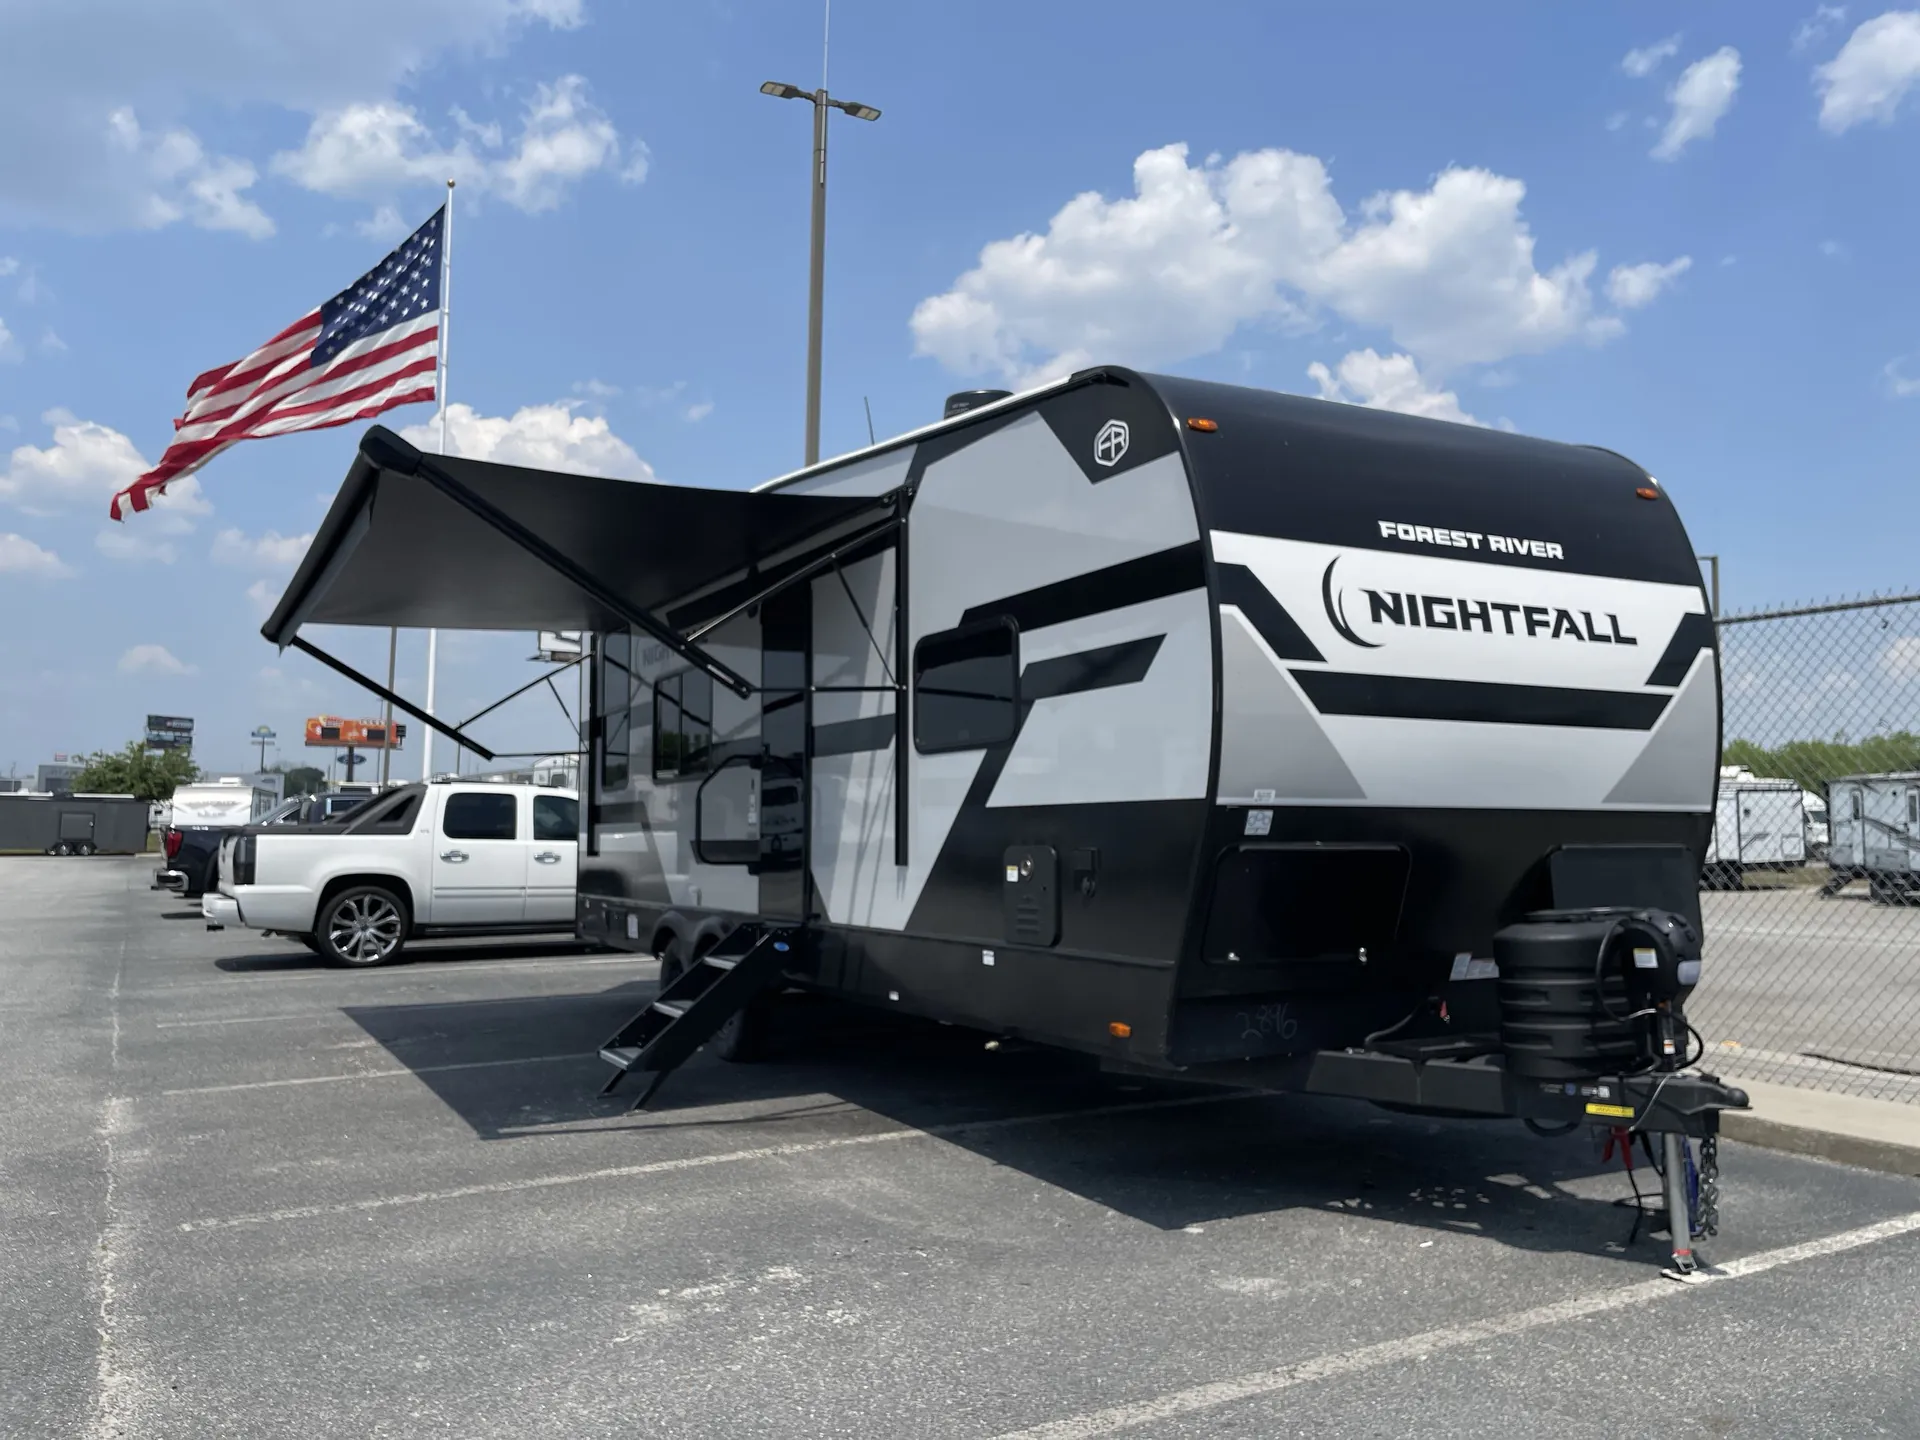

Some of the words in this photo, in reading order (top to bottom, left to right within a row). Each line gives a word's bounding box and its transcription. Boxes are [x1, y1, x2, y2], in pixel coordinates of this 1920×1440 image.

[1377, 520, 1483, 550] FOREST
[1487, 534, 1564, 560] RIVER
[1358, 588, 1638, 646] NIGHTFALL
